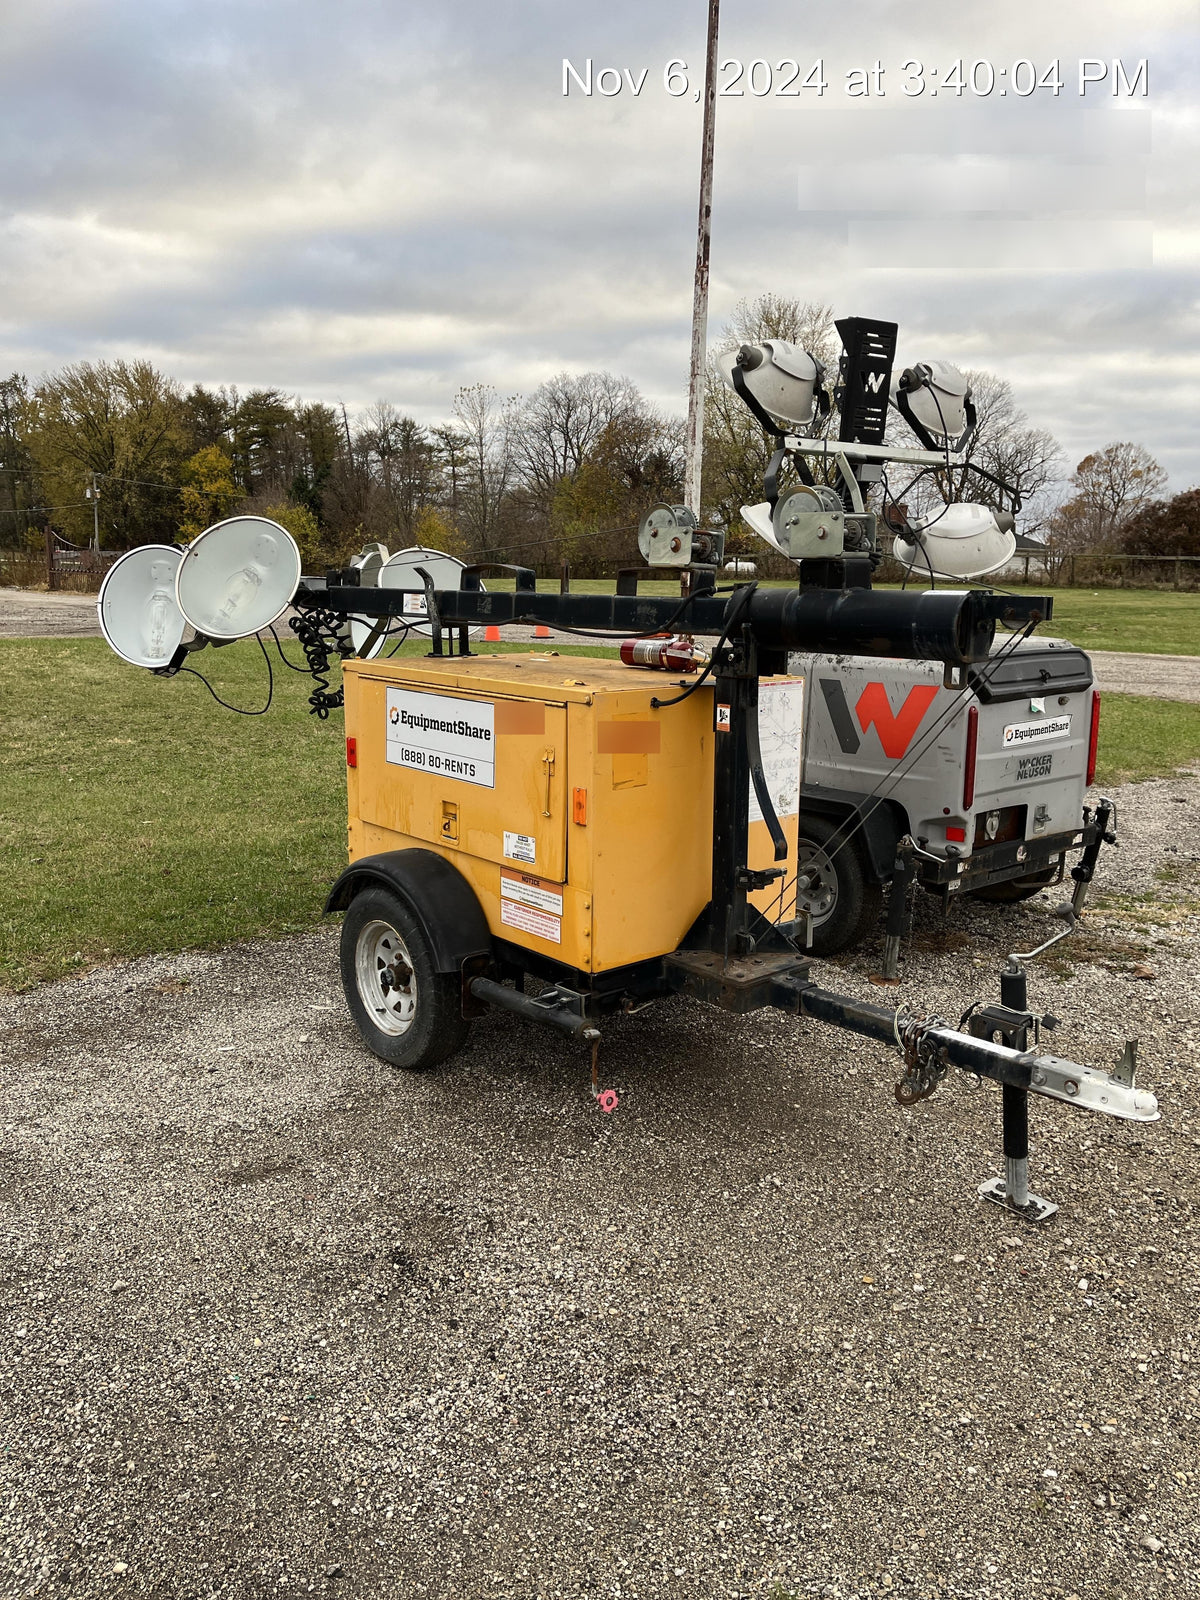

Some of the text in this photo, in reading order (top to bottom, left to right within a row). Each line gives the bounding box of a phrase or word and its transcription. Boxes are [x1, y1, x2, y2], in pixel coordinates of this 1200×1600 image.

[401, 710, 491, 741] EquipmentShare
[1014, 722, 1069, 741] EquipmentShare
[401, 747, 476, 777] (888) 80-RENTS
[1016, 765, 1052, 781] NEUSON
[522, 876, 540, 886] NOTICE
